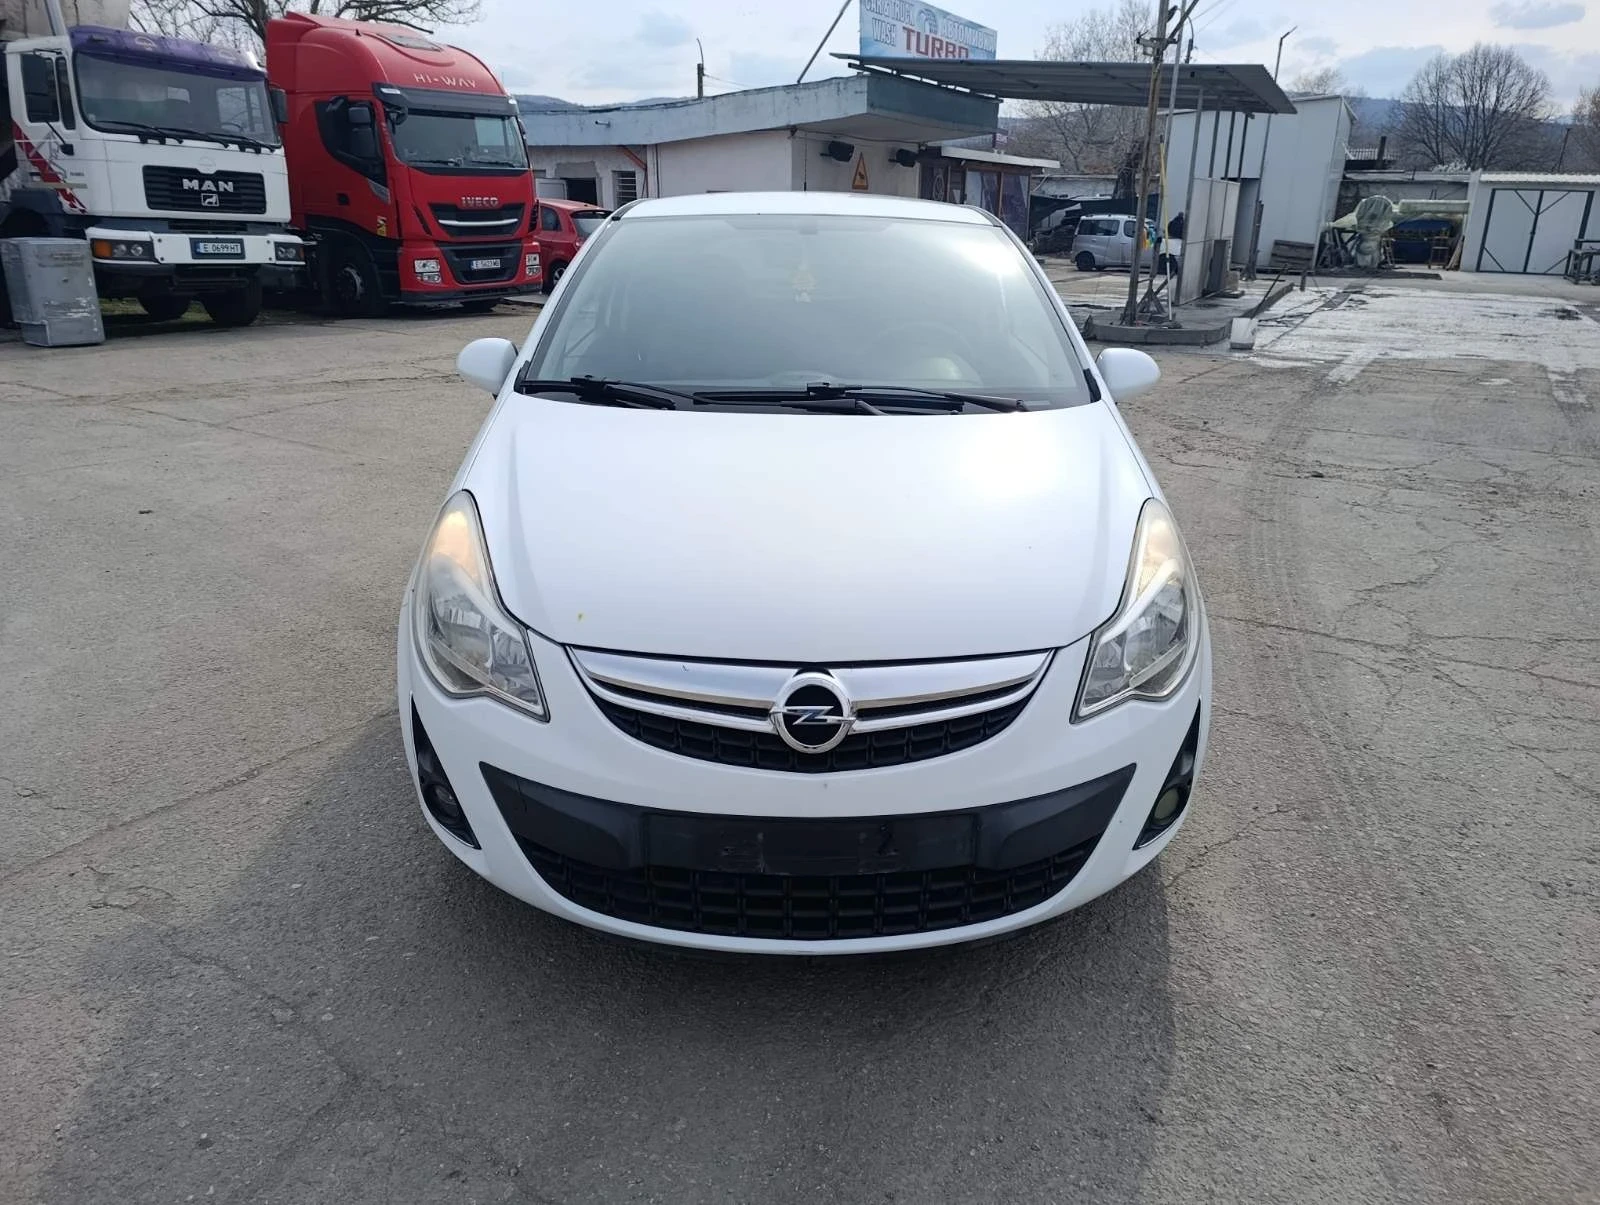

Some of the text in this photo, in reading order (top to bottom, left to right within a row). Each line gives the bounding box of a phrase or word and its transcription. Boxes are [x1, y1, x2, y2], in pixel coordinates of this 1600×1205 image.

[412, 73, 477, 88] HI-WAY
[182, 178, 234, 193] MAN
[461, 196, 499, 208] IVECO
